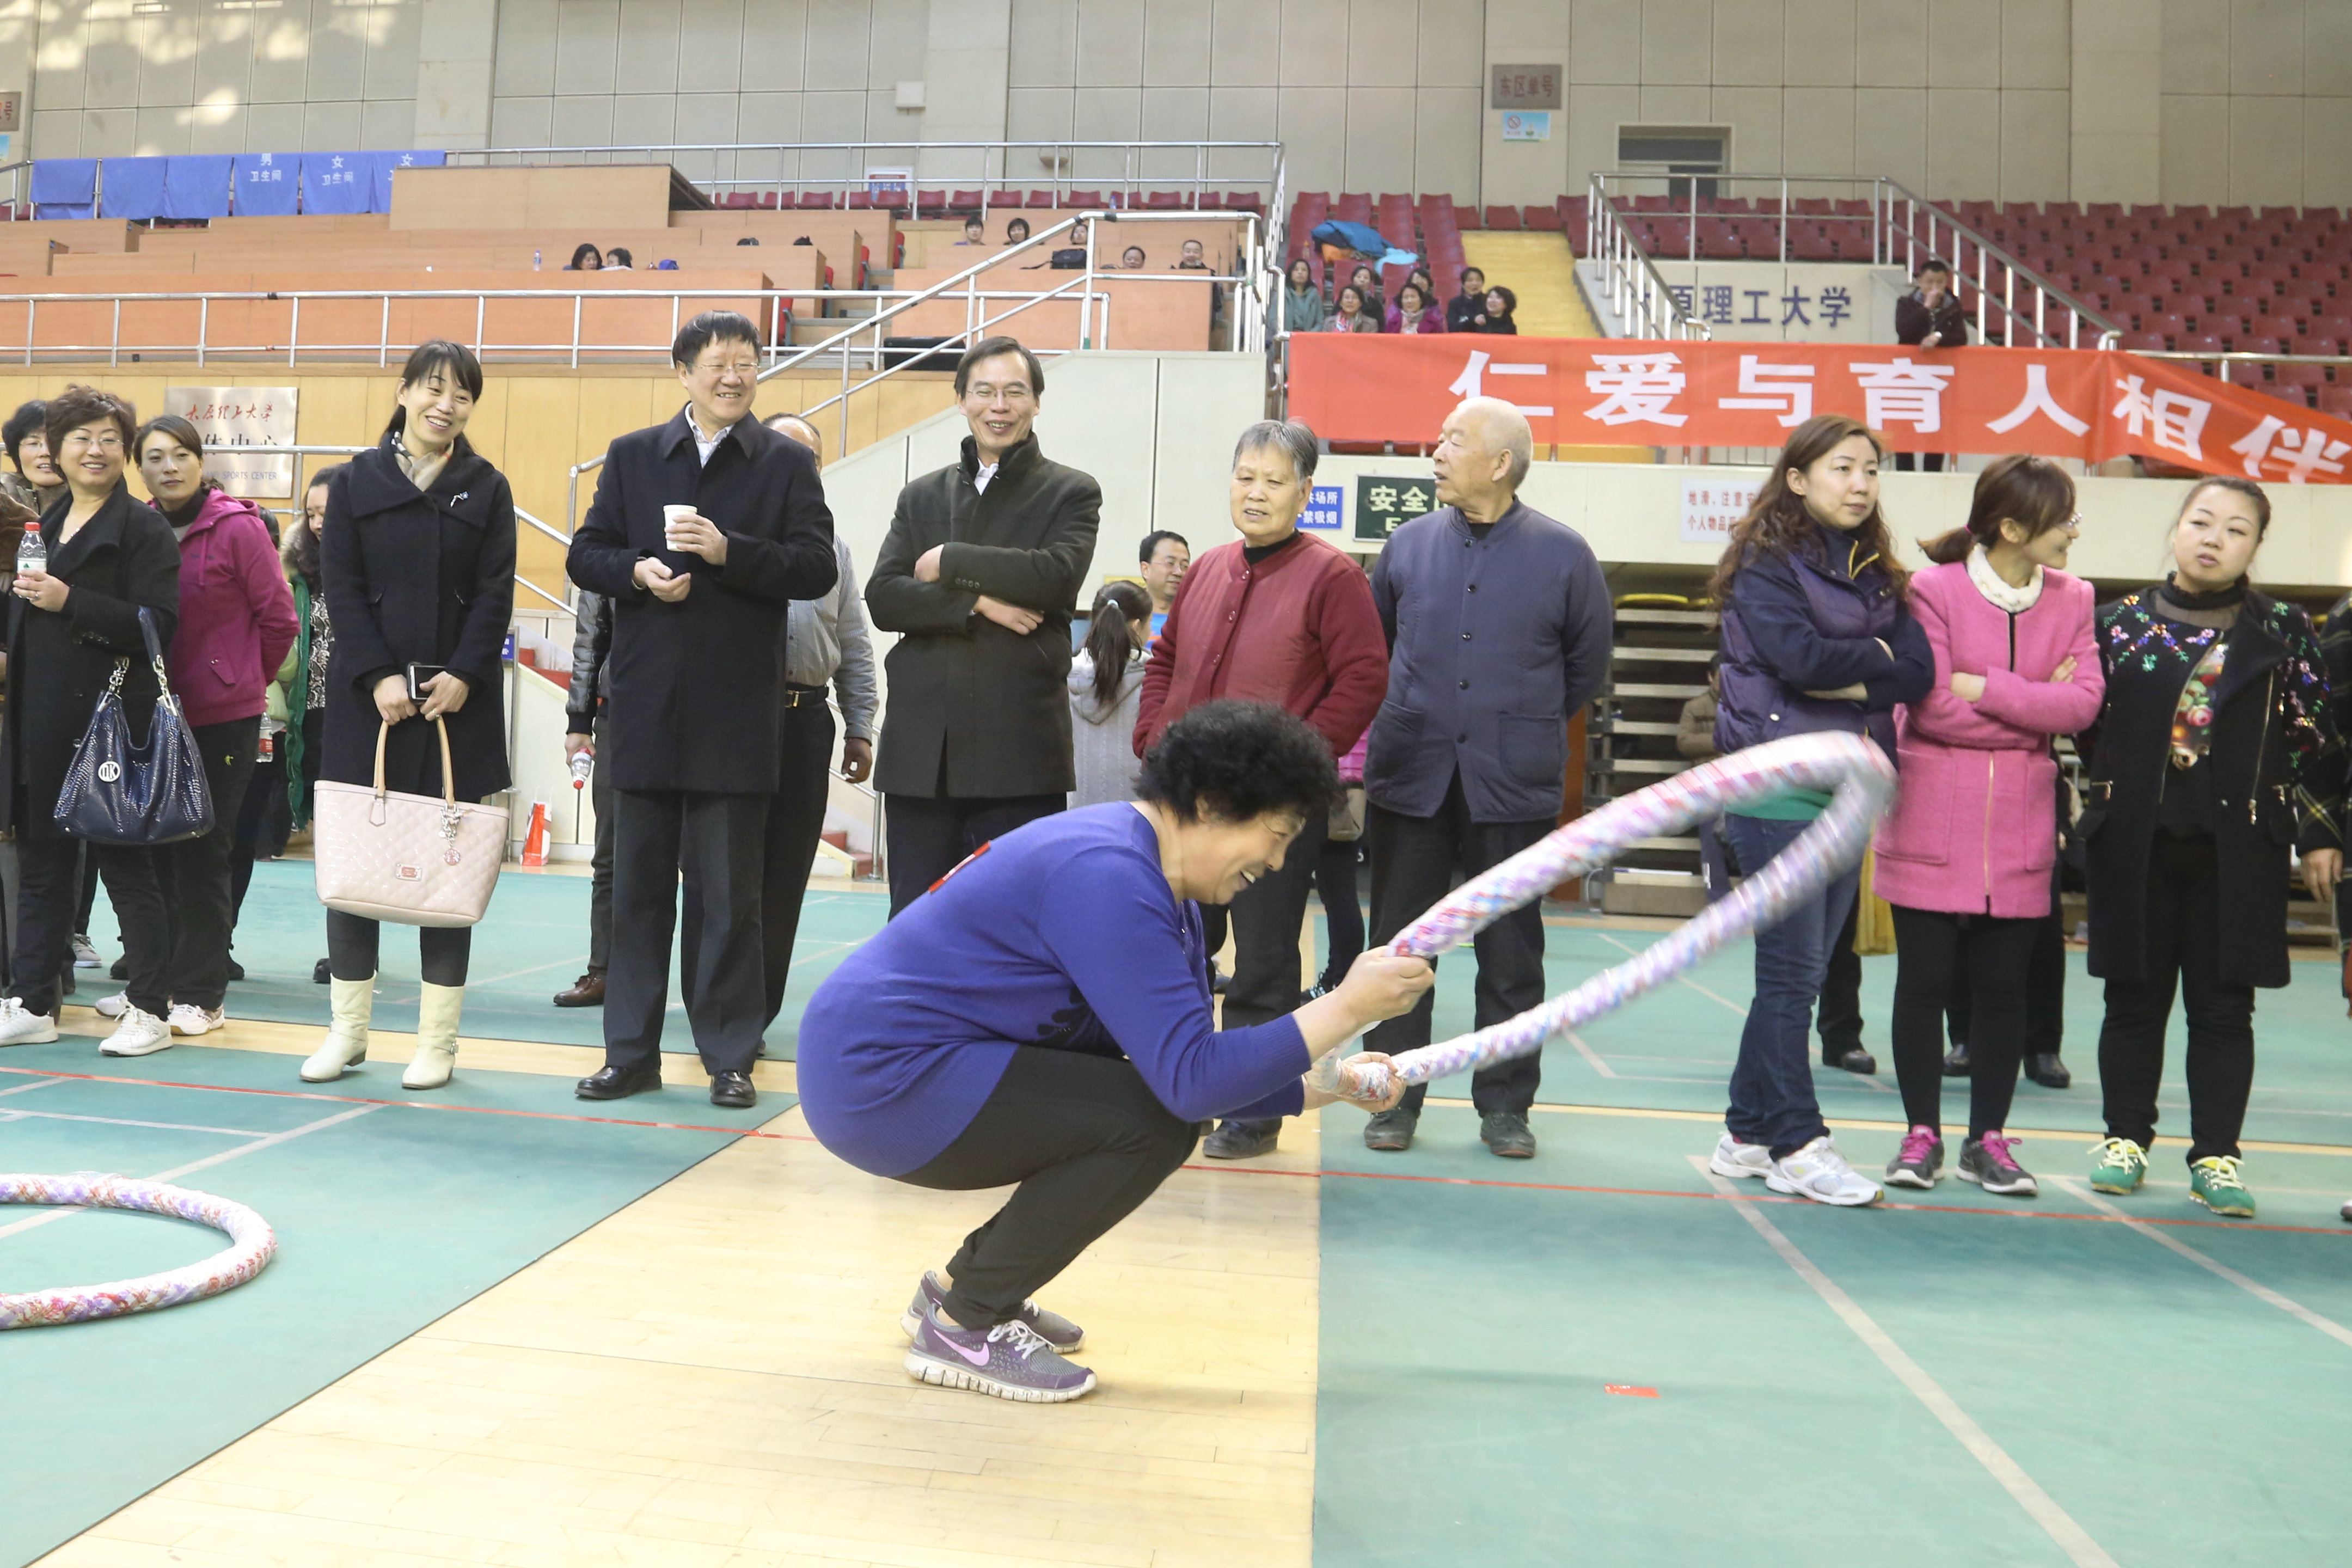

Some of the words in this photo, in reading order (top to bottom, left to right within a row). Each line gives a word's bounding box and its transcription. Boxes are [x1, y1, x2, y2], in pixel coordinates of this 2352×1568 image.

[0, 101, 13, 120] 号
[260, 152, 272, 166] 男
[332, 155, 344, 168] 女
[401, 153, 413, 167] 女
[250, 170, 282, 182] 卫生间
[322, 171, 354, 186] 卫生间
[252, 471, 277, 480] CENTER
[1297, 510, 1338, 524] 禁吸烟
